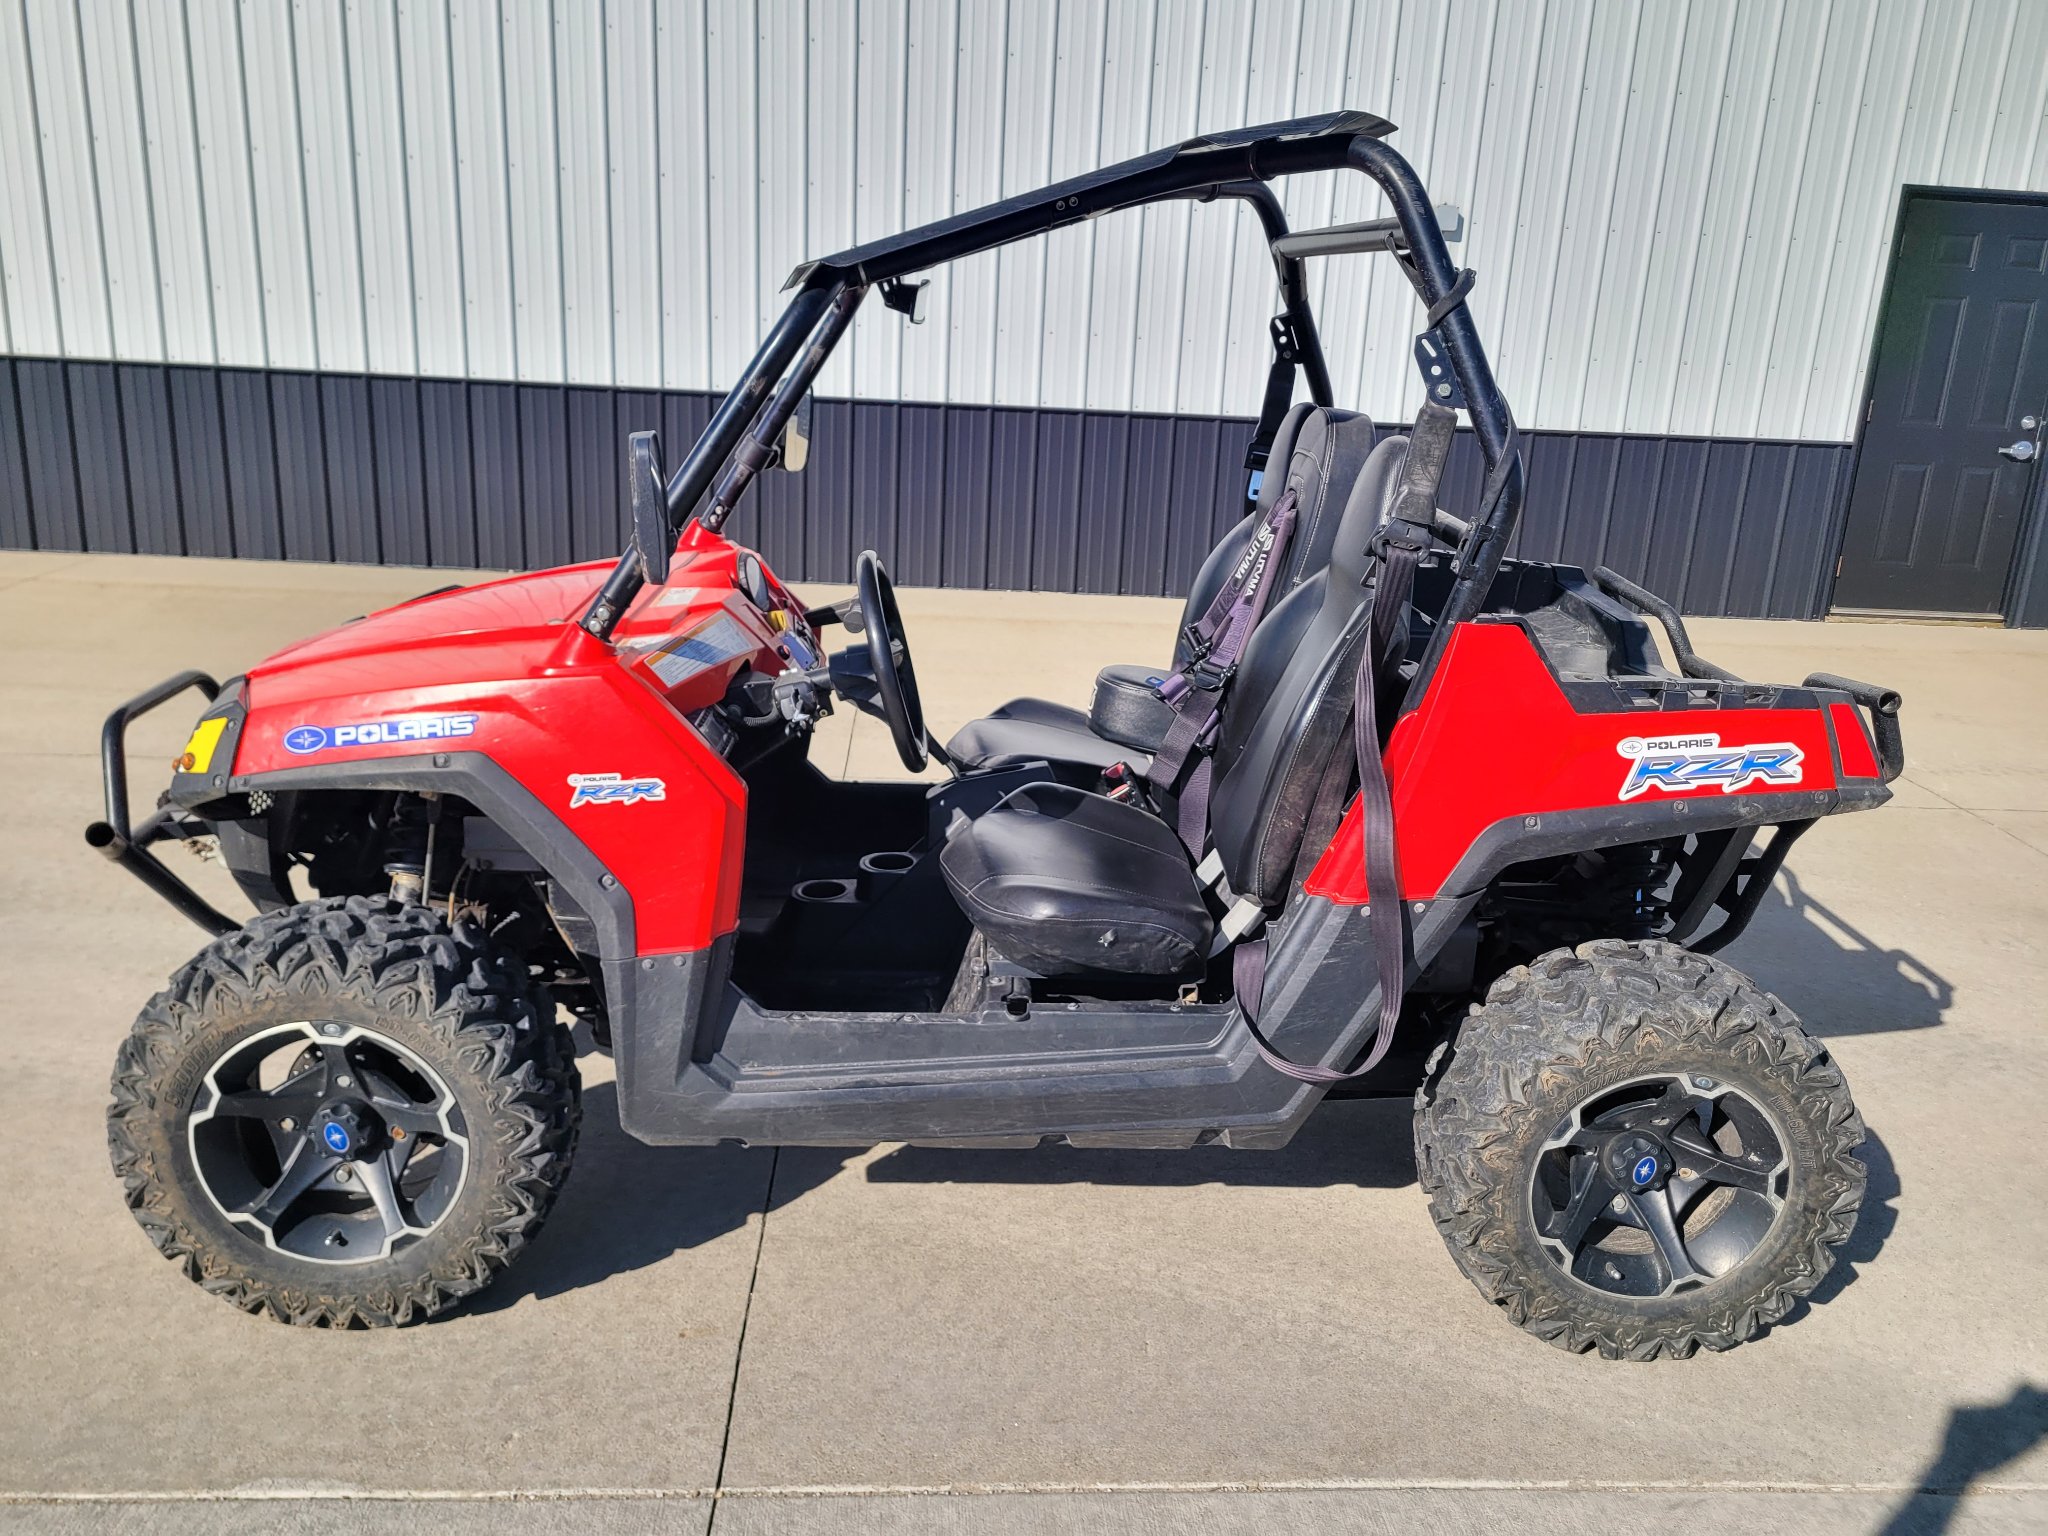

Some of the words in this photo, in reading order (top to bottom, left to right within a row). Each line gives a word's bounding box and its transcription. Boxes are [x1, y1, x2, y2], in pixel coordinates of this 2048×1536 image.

[1235, 540, 1260, 579] UTVMA
[1245, 553, 1267, 597] UTVMA
[334, 715, 477, 746] POLARIS
[1647, 739, 1713, 750] POLARIS
[1624, 748, 1799, 795] RZR
[573, 782, 662, 804] RZR
